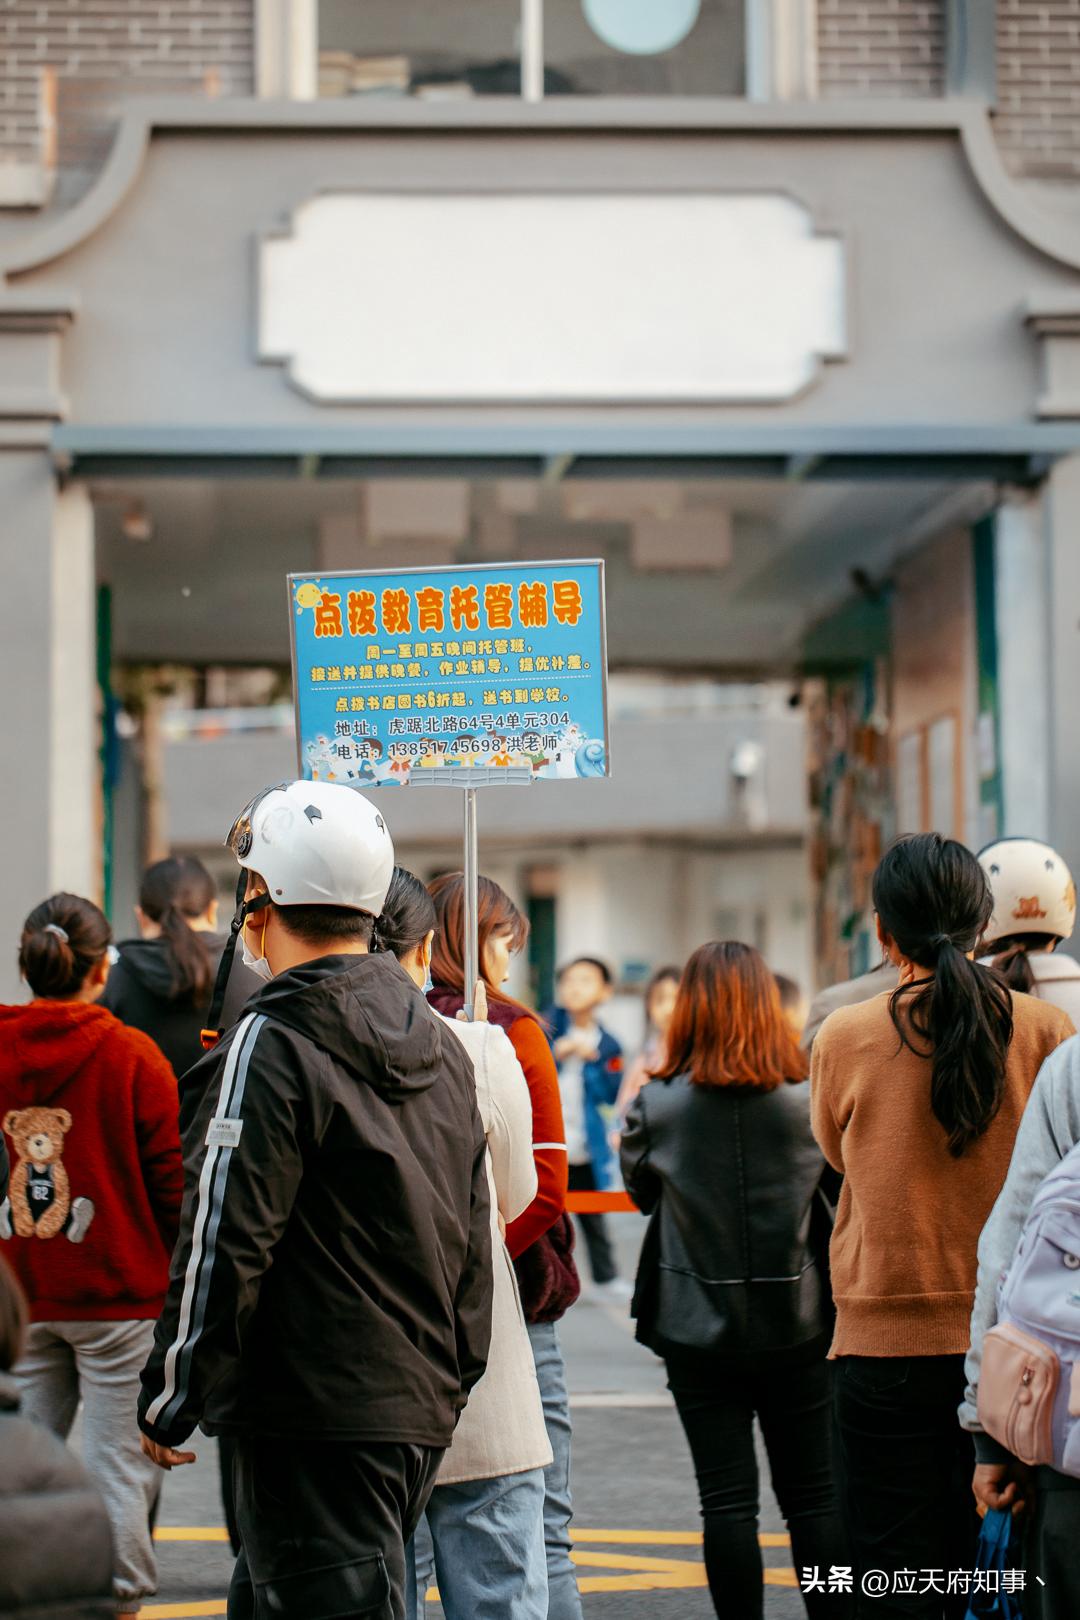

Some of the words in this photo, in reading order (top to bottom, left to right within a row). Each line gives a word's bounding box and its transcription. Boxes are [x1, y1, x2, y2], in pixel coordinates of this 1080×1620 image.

[313, 580, 583, 638] 点拨教育托管辅导
[366, 638, 533, 660] 周一至周五晚间托管班，
